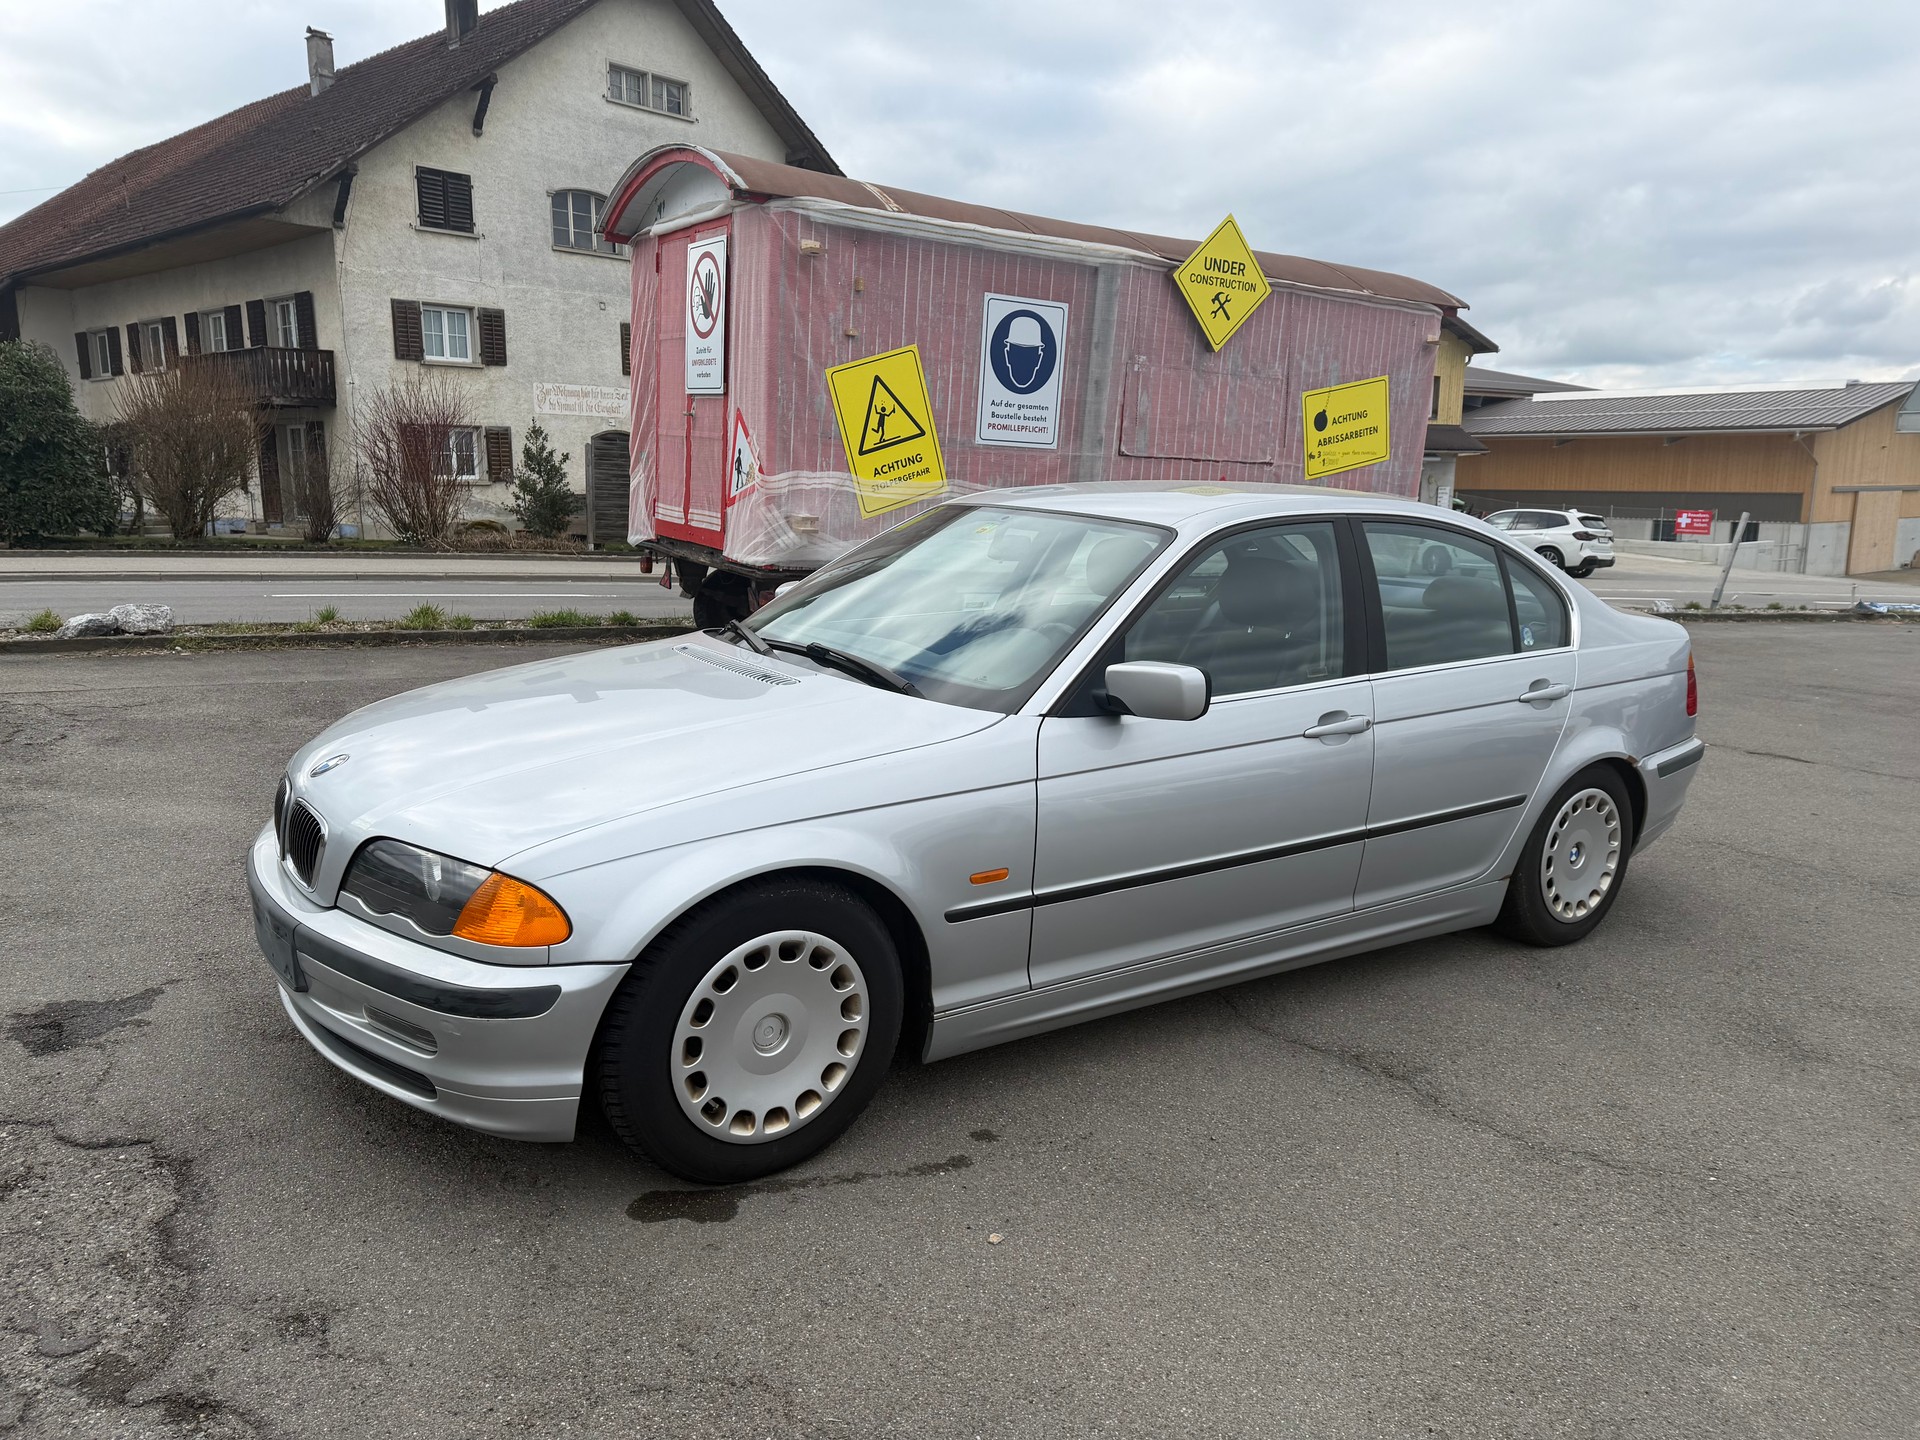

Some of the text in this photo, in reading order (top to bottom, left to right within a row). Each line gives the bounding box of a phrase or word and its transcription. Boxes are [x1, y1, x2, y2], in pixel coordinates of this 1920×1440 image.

[1204, 256, 1246, 277] UNDER
[1189, 272, 1257, 293] CONSTRUCTION
[990, 399, 1049, 411] Auf der gesamten
[991, 411, 1047, 422] Baustelle besteht
[1331, 409, 1368, 426] ACHTUNG
[987, 422, 1049, 434] PROMILLEPFLICHT!
[1317, 425, 1379, 448] ABRISSARBEITEN
[873, 453, 923, 478] ACHTUNG
[871, 467, 931, 493] STOLPERGEFAHR
